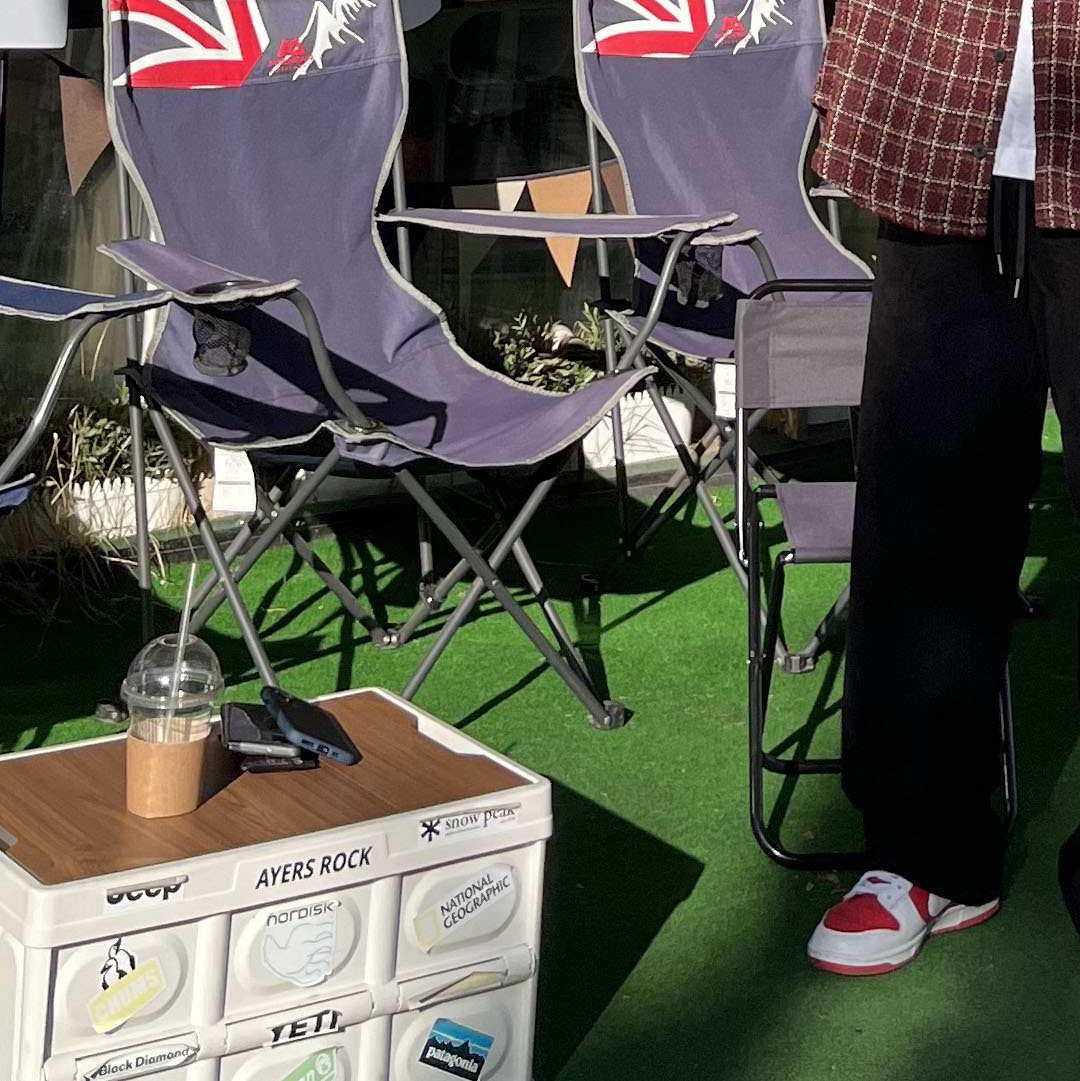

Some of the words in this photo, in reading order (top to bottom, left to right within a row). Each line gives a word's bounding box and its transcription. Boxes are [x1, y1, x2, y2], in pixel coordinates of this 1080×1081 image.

[445, 812, 481, 831] snow
[255, 858, 316, 890] AYERS
[319, 845, 373, 878] ROCK
[440, 874, 495, 916] NATIONAL
[443, 874, 512, 929] GEOGRAPHIC
[271, 1009, 341, 1043] YETI
[98, 1059, 133, 1077] Black
[135, 1047, 190, 1068] Diamond
[425, 1045, 480, 1075] patagonia
